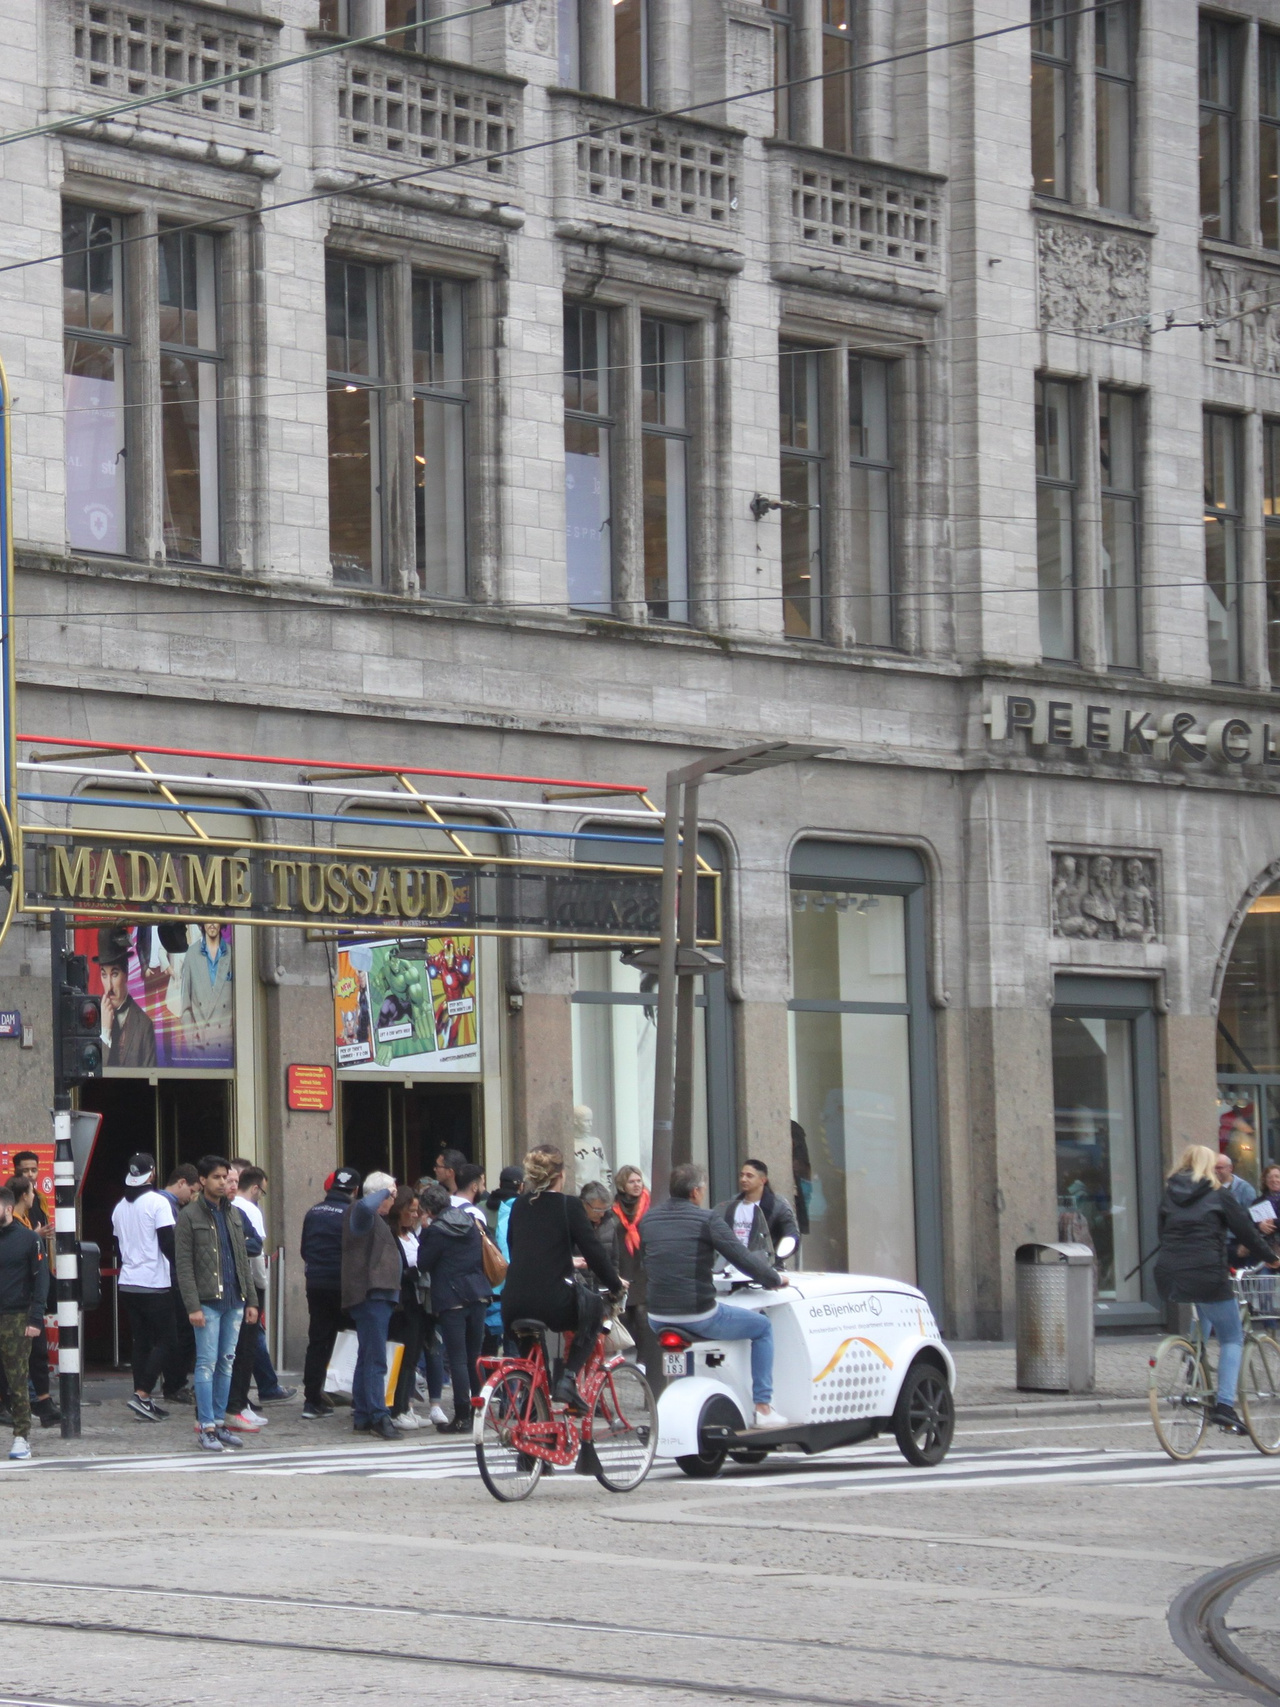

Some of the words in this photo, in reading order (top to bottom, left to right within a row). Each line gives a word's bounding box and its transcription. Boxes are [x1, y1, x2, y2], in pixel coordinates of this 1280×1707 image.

[50, 845, 252, 908] MADAME
[267, 859, 456, 918] TUSSAUD
[1, 1014, 16, 1025] DAM
[809, 1306, 823, 1318] de
[823, 1300, 868, 1318] Bijenkorf
[666, 1364, 684, 1374] 183
